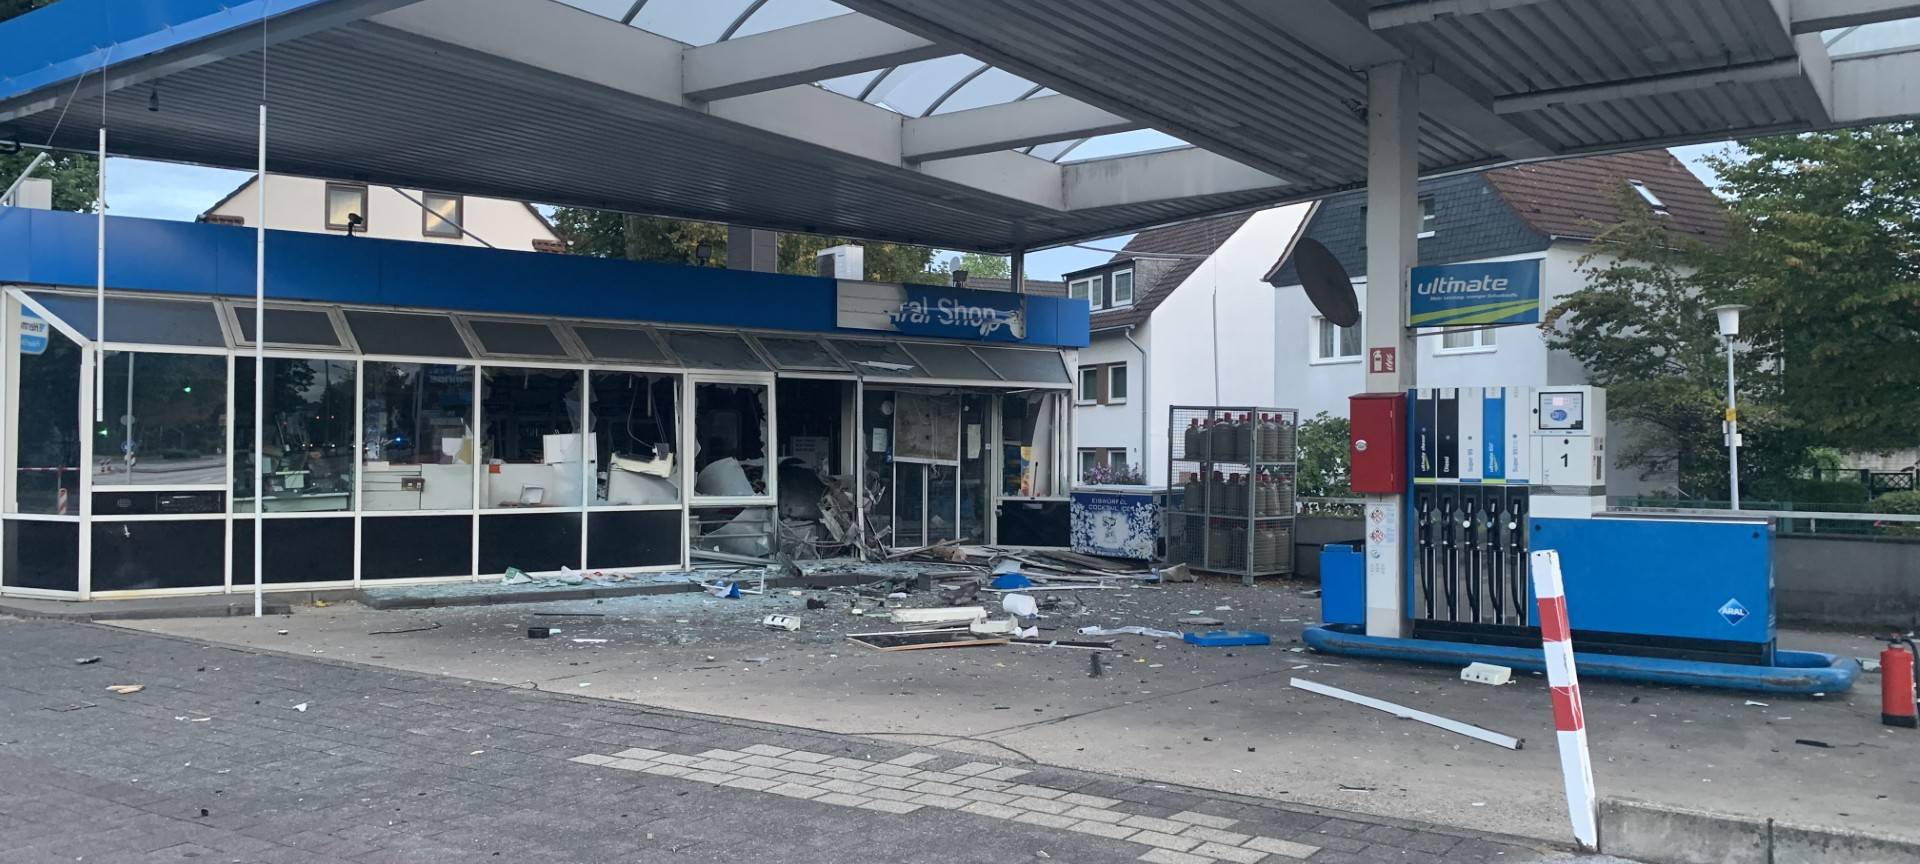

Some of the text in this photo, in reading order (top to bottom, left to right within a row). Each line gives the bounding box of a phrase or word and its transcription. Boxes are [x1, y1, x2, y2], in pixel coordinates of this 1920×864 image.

[1417, 274, 1509, 295] ultimate
[1560, 452, 1568, 468] 1
[1722, 607, 1745, 616] ARAL
